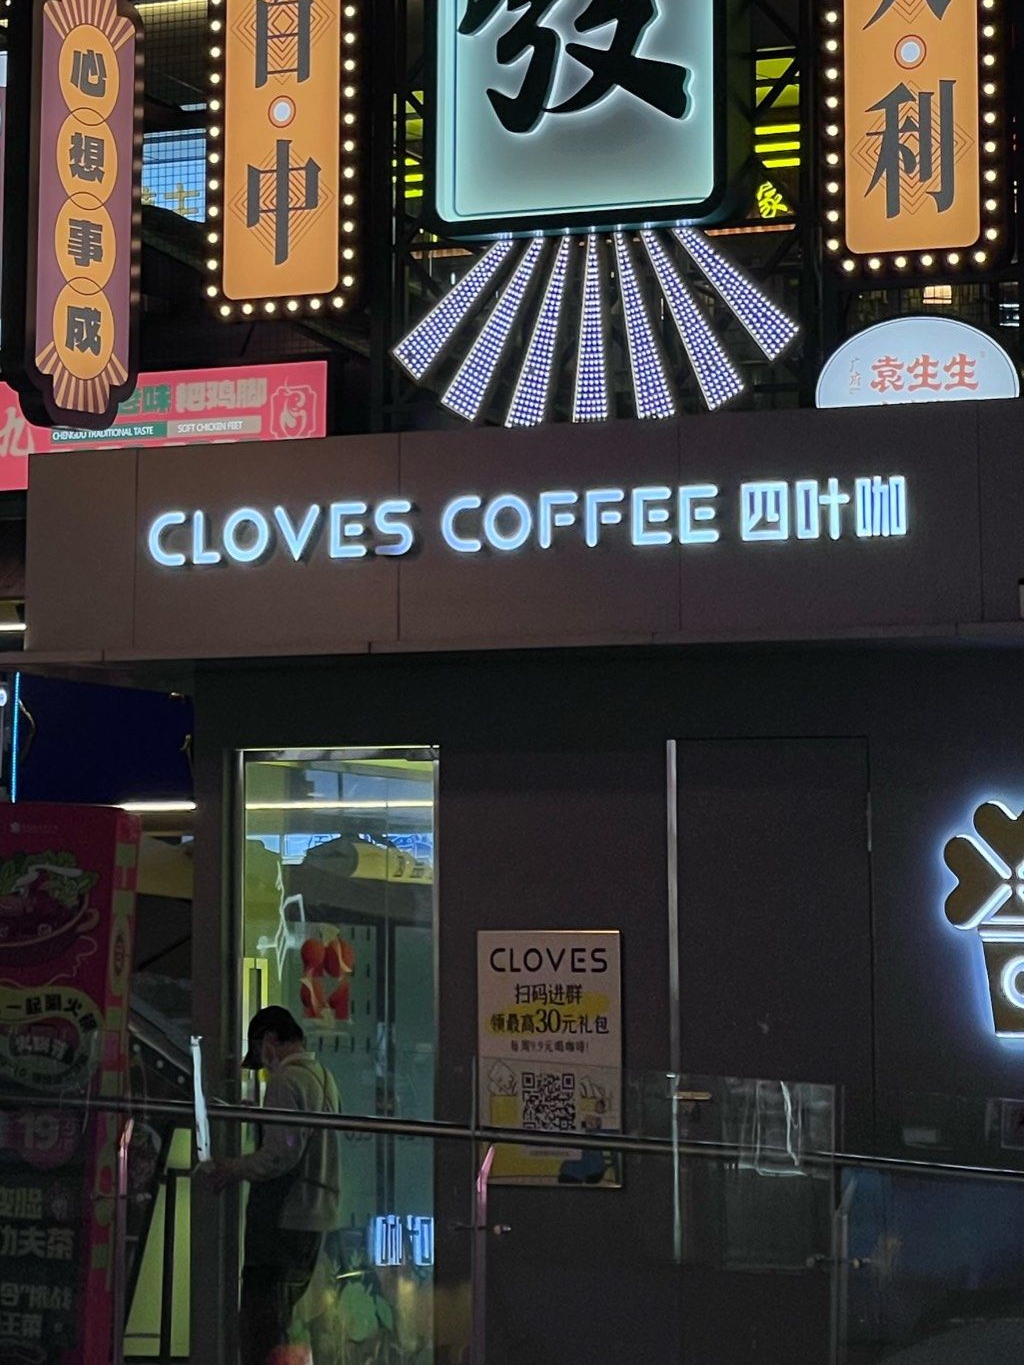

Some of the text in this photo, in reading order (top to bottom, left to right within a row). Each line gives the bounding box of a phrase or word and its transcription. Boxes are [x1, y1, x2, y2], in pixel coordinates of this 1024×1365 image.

[65, 49, 108, 356] 心想事成
[869, 353, 980, 394] 袁生生
[134, 426, 154, 436] TASTE
[177, 420, 243, 433] SOFT CHICKEN FEET
[741, 475, 908, 542] 四叶咖
[148, 483, 719, 567] CLOVES COFFEE
[490, 947, 608, 973] CLOVES
[515, 984, 583, 1005] 扫码进群
[491, 1008, 610, 1035] 领最高30元礼包
